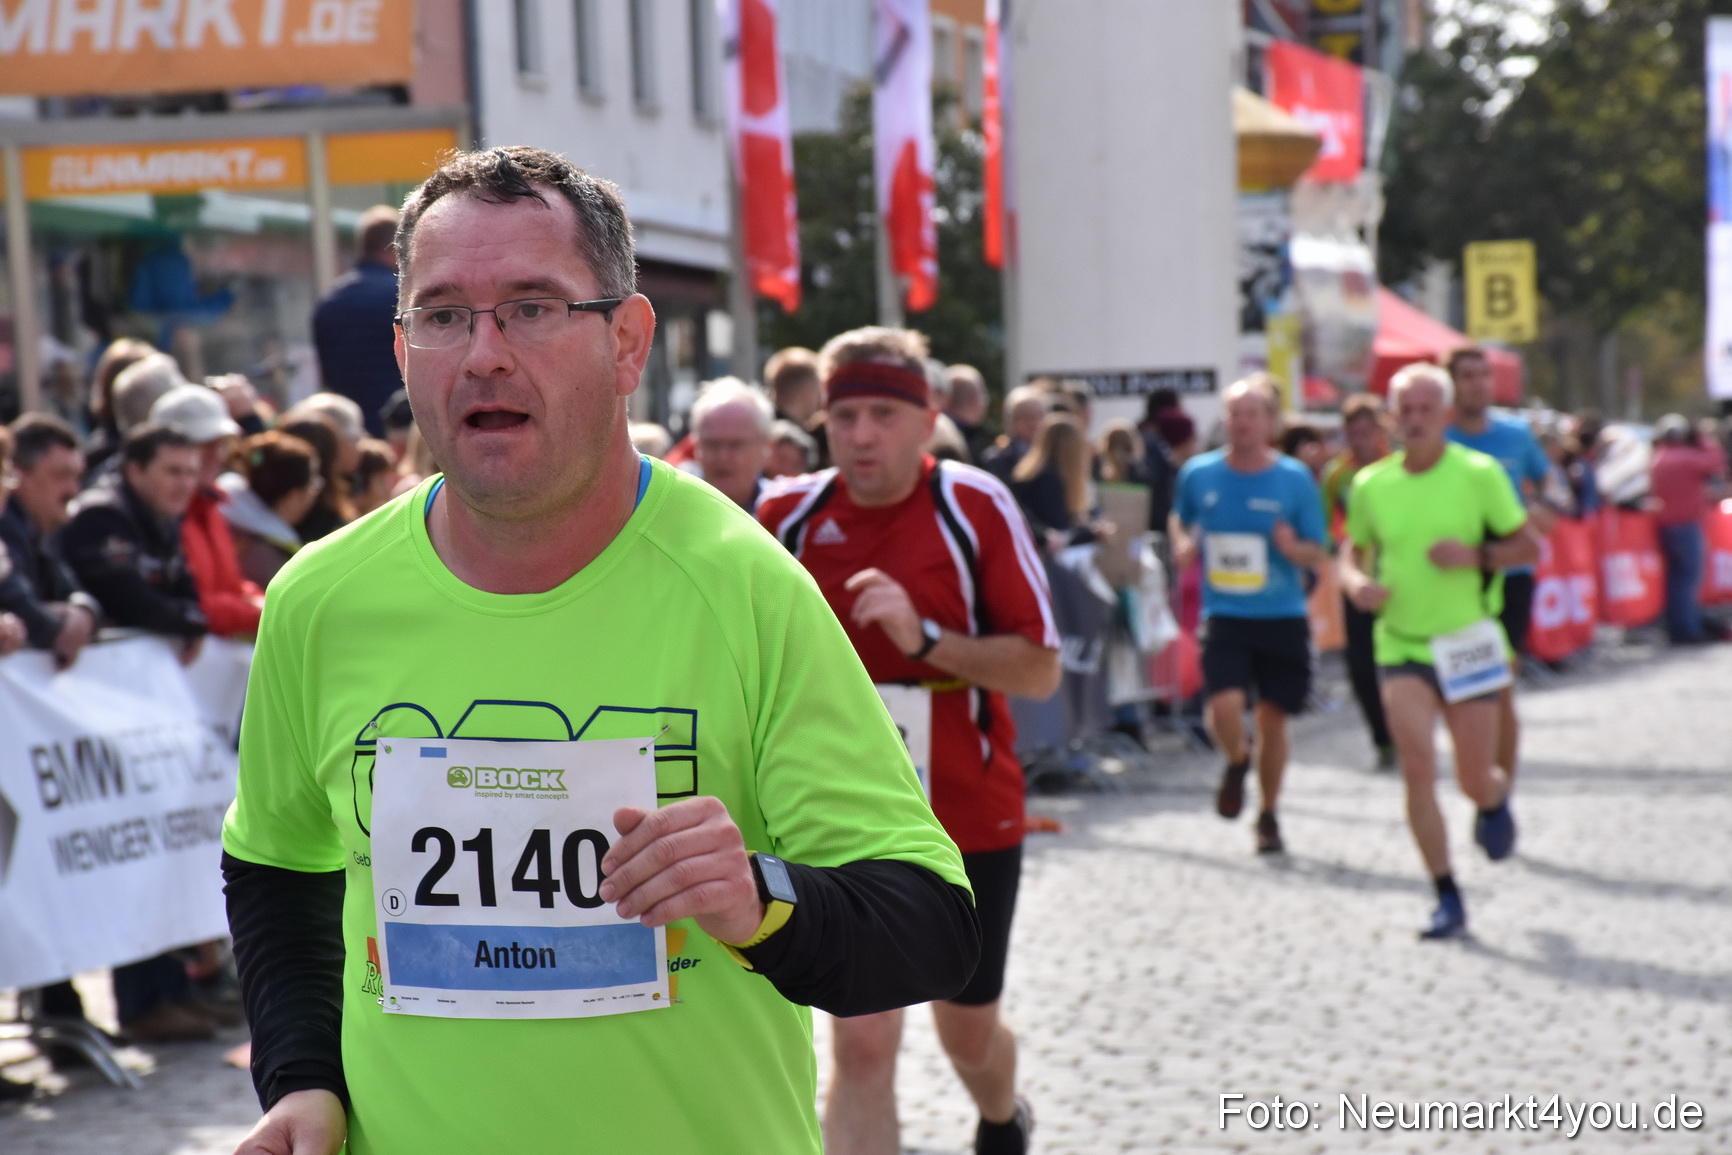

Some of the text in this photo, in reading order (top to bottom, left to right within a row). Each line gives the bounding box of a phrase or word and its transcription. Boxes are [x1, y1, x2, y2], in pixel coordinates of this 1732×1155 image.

[1484, 272, 1519, 319] B
[29, 736, 124, 810] BMW
[475, 767, 568, 791] BOCK
[474, 790, 569, 801] inspired by smart concepts
[411, 826, 611, 909] 2140
[390, 896, 399, 910] D
[474, 940, 556, 969] Anton
